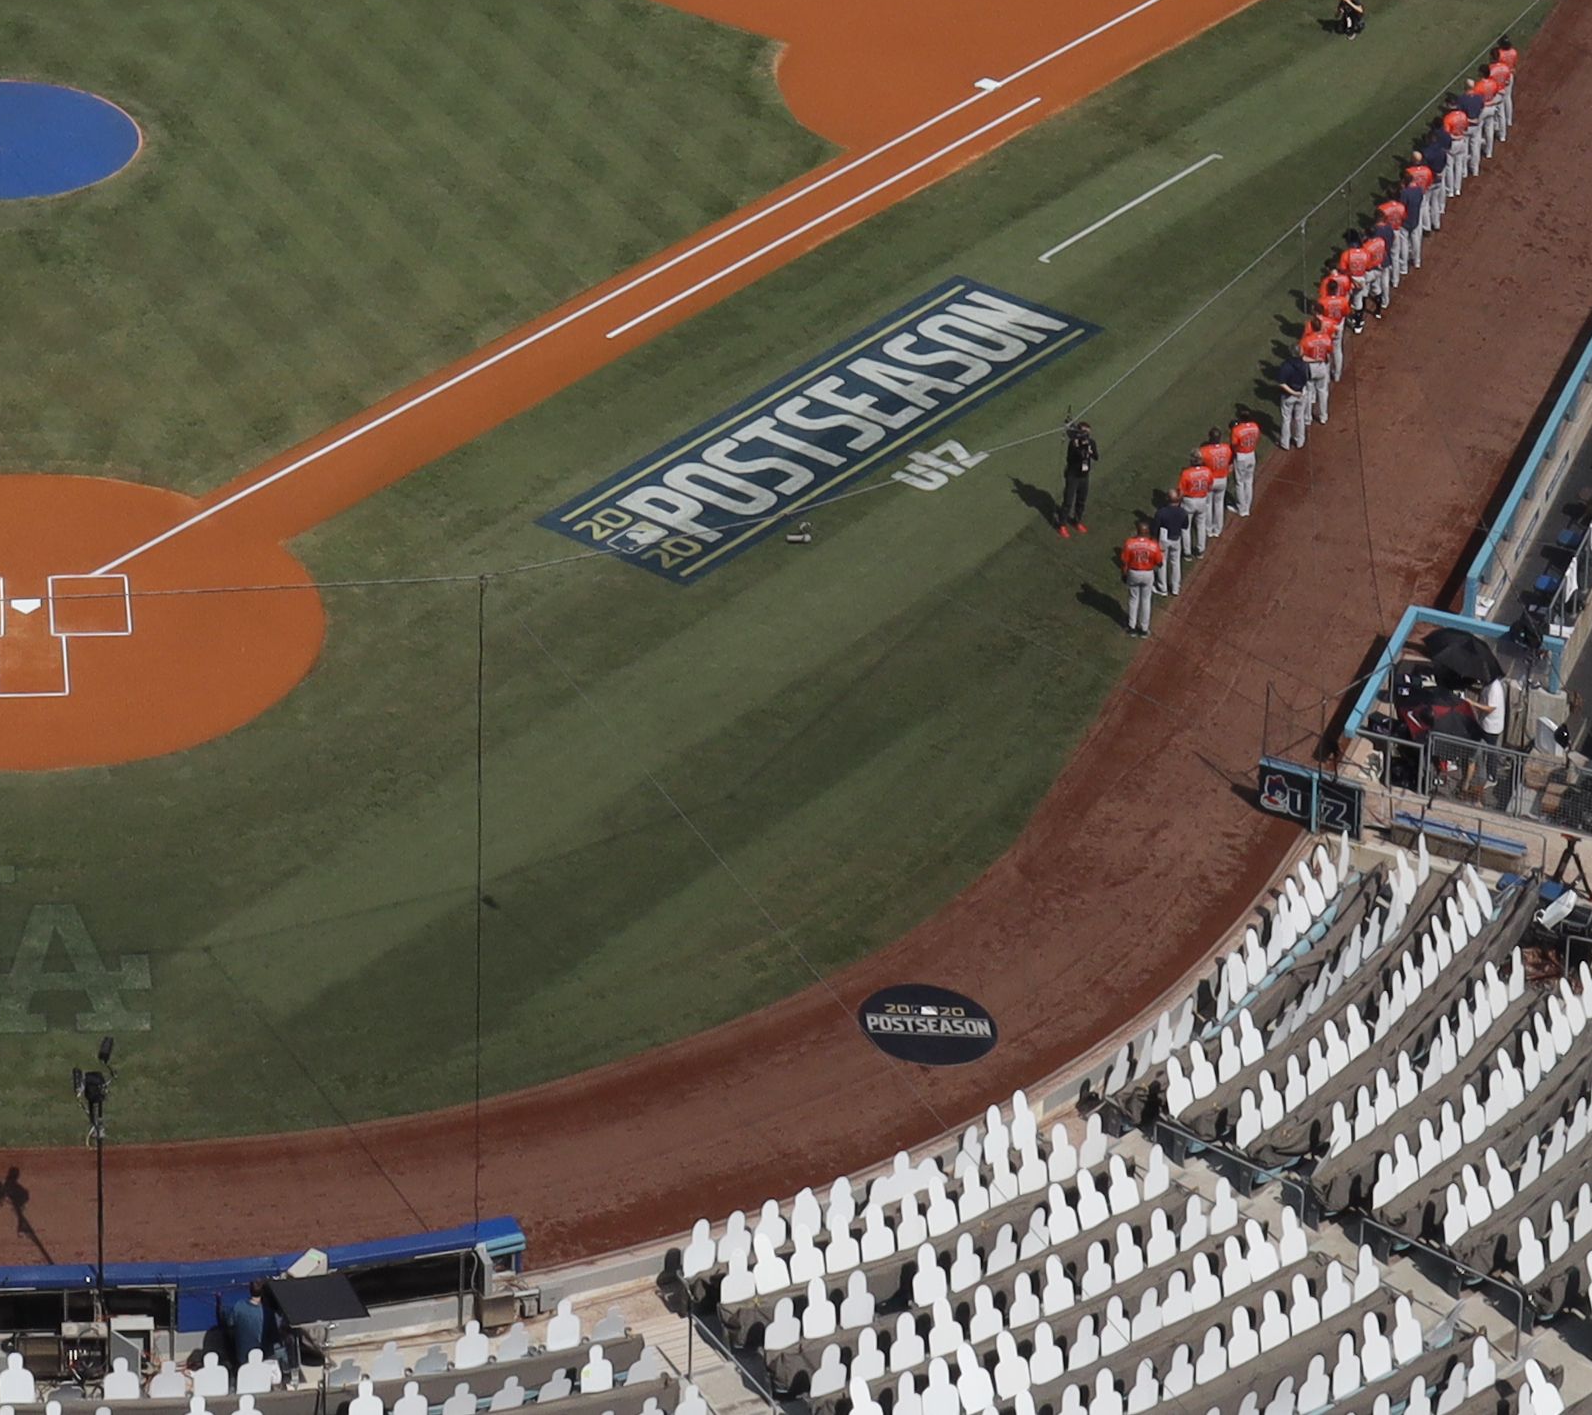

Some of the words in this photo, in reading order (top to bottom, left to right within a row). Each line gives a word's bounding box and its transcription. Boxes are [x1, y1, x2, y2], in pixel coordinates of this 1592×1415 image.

[621, 290, 1069, 546] POSTSEASON
[891, 439, 990, 492] utz
[573, 506, 633, 542] 20
[648, 535, 702, 568] 20
[866, 1014, 992, 1037] POSTSEASON
[884, 1003, 910, 1015] 20
[939, 1005, 965, 1017] 20
